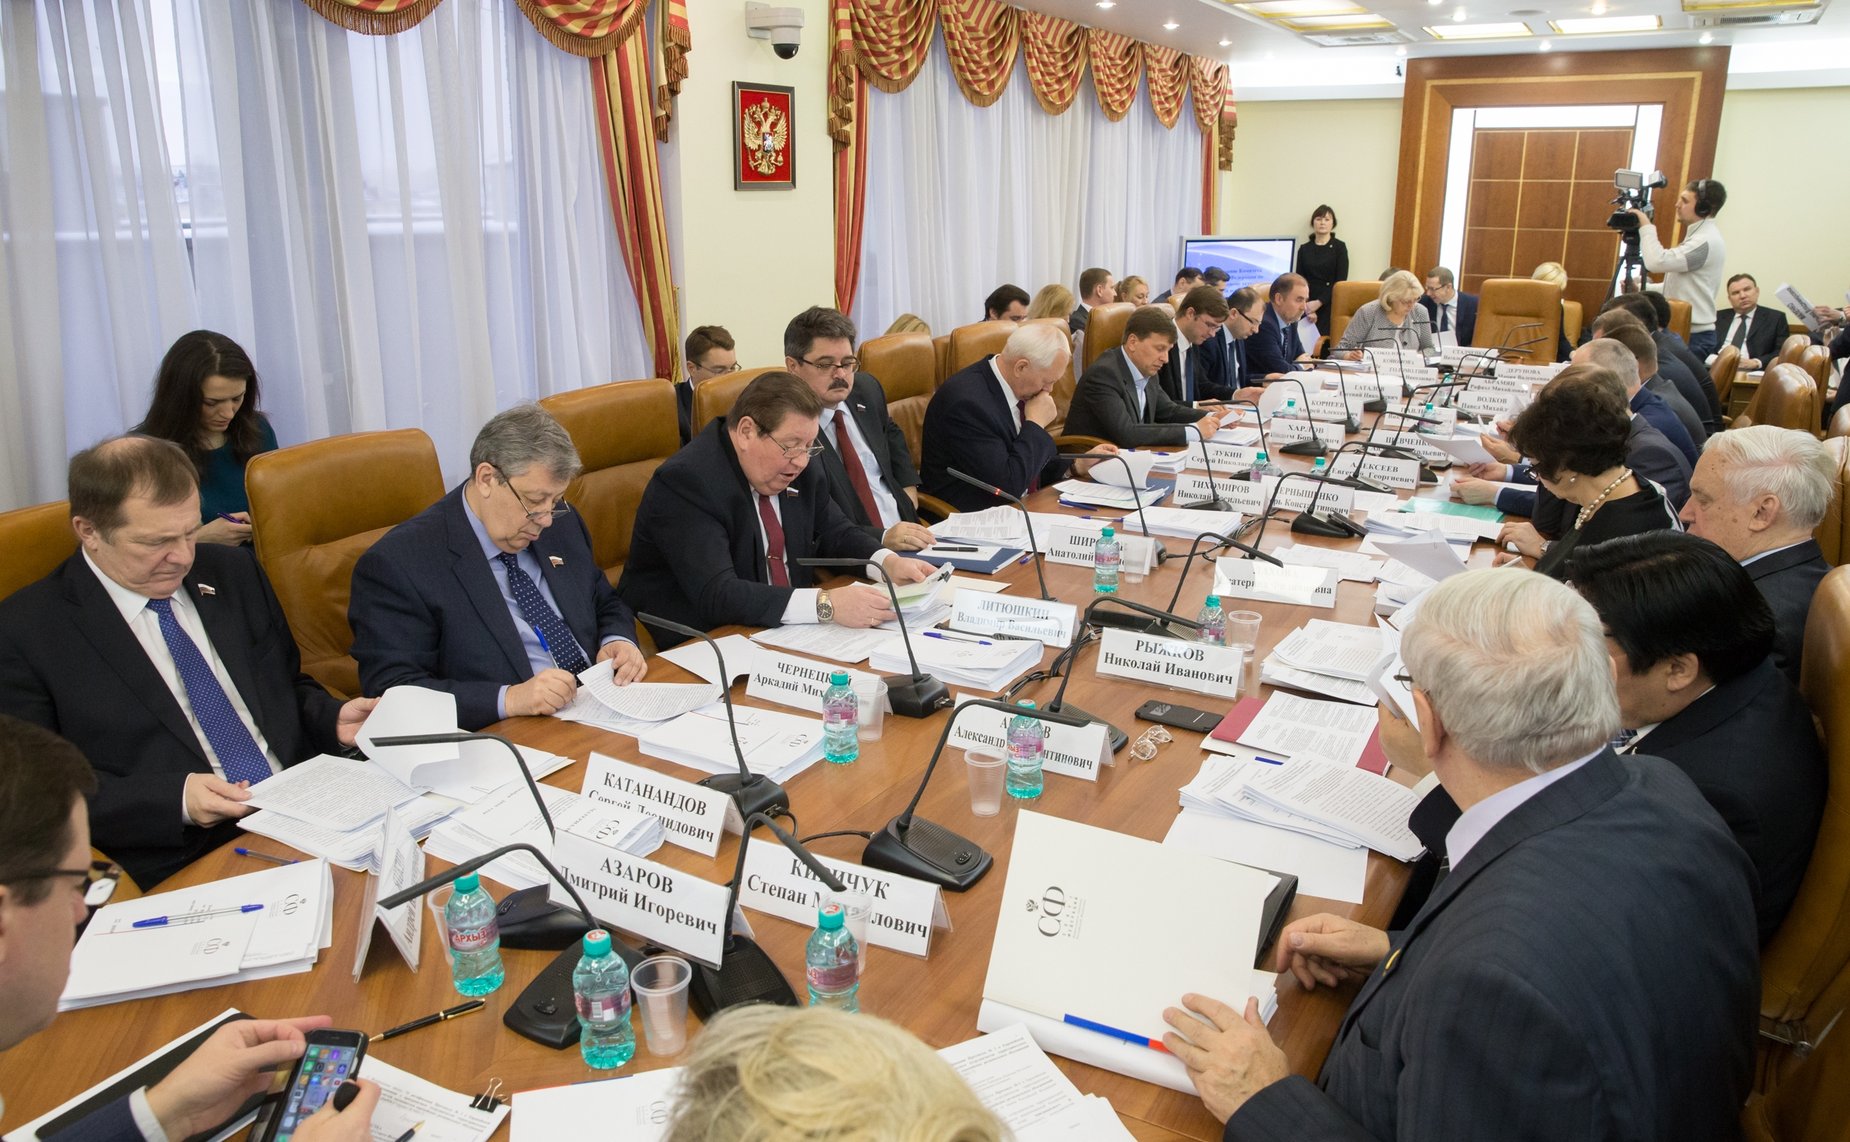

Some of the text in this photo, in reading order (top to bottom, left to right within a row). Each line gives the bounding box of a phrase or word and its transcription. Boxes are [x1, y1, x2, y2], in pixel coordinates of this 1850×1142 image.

[1213, 450, 1242, 458] ЛУКИН
[1350, 462, 1399, 472] АЕКСЕЕВ
[1368, 472, 1415, 484] Георгиевич
[1177, 489, 1212, 501] Николай
[1278, 486, 1339, 502] ЕРНЫШНКО
[1047, 547, 1095, 562] Анатолий
[977, 600, 1050, 620] ЛИТЮШКИН
[957, 611, 1067, 639] Владимир Васильевич
[1135, 639, 1204, 662] РЫЖКОВ
[1104, 651, 1233, 686] Николай Иванович
[753, 673, 799, 693] Аркадий
[954, 725, 1006, 749] Александр
[603, 772, 708, 816] КАТАНАНДОВ
[600, 857, 673, 895] АЗАРОВ
[790, 858, 890, 900] КИИЧУК
[558, 865, 718, 936] Дмитрий Игоревич
[747, 874, 808, 906] Степан
[455, 928, 487, 944] АРХЫЗ
